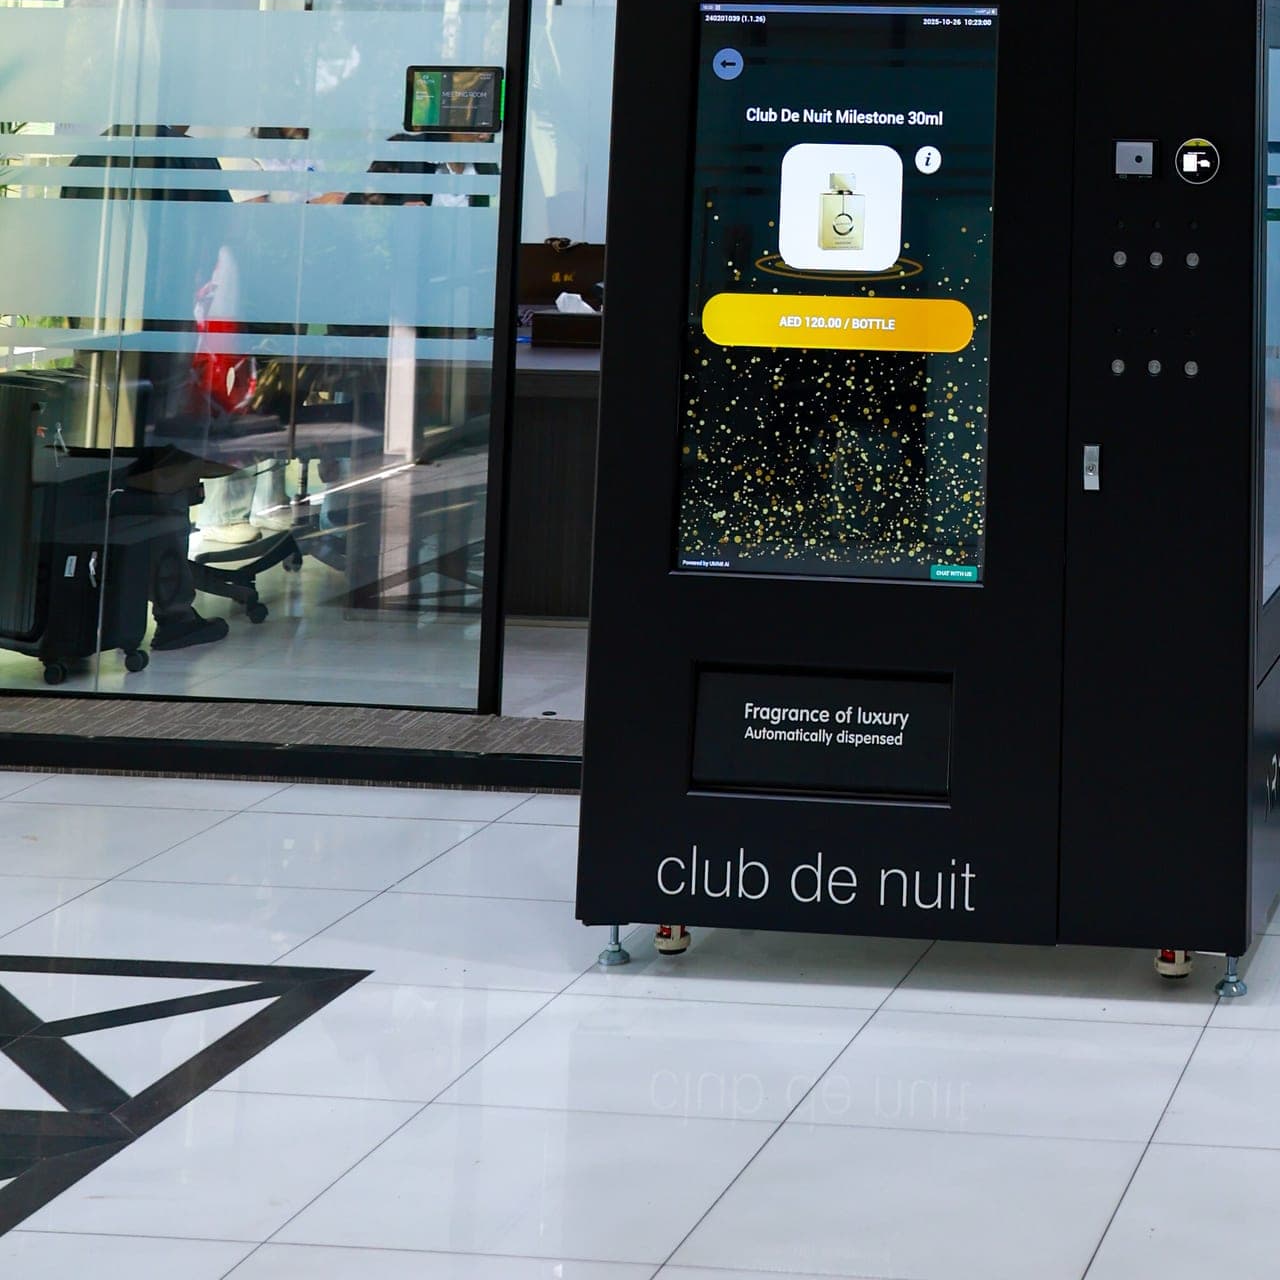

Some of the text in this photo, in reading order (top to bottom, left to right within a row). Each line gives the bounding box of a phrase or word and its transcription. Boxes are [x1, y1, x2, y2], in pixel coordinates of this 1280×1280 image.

[746, 107, 943, 126] Club De Nuit Milestone 30ml
[779, 316, 895, 330] AED 120.00 / BOTTLE
[744, 702, 909, 730] Fragrance of luxury
[744, 726, 903, 747] Automatically dispensed
[657, 845, 976, 911] club de nuit
